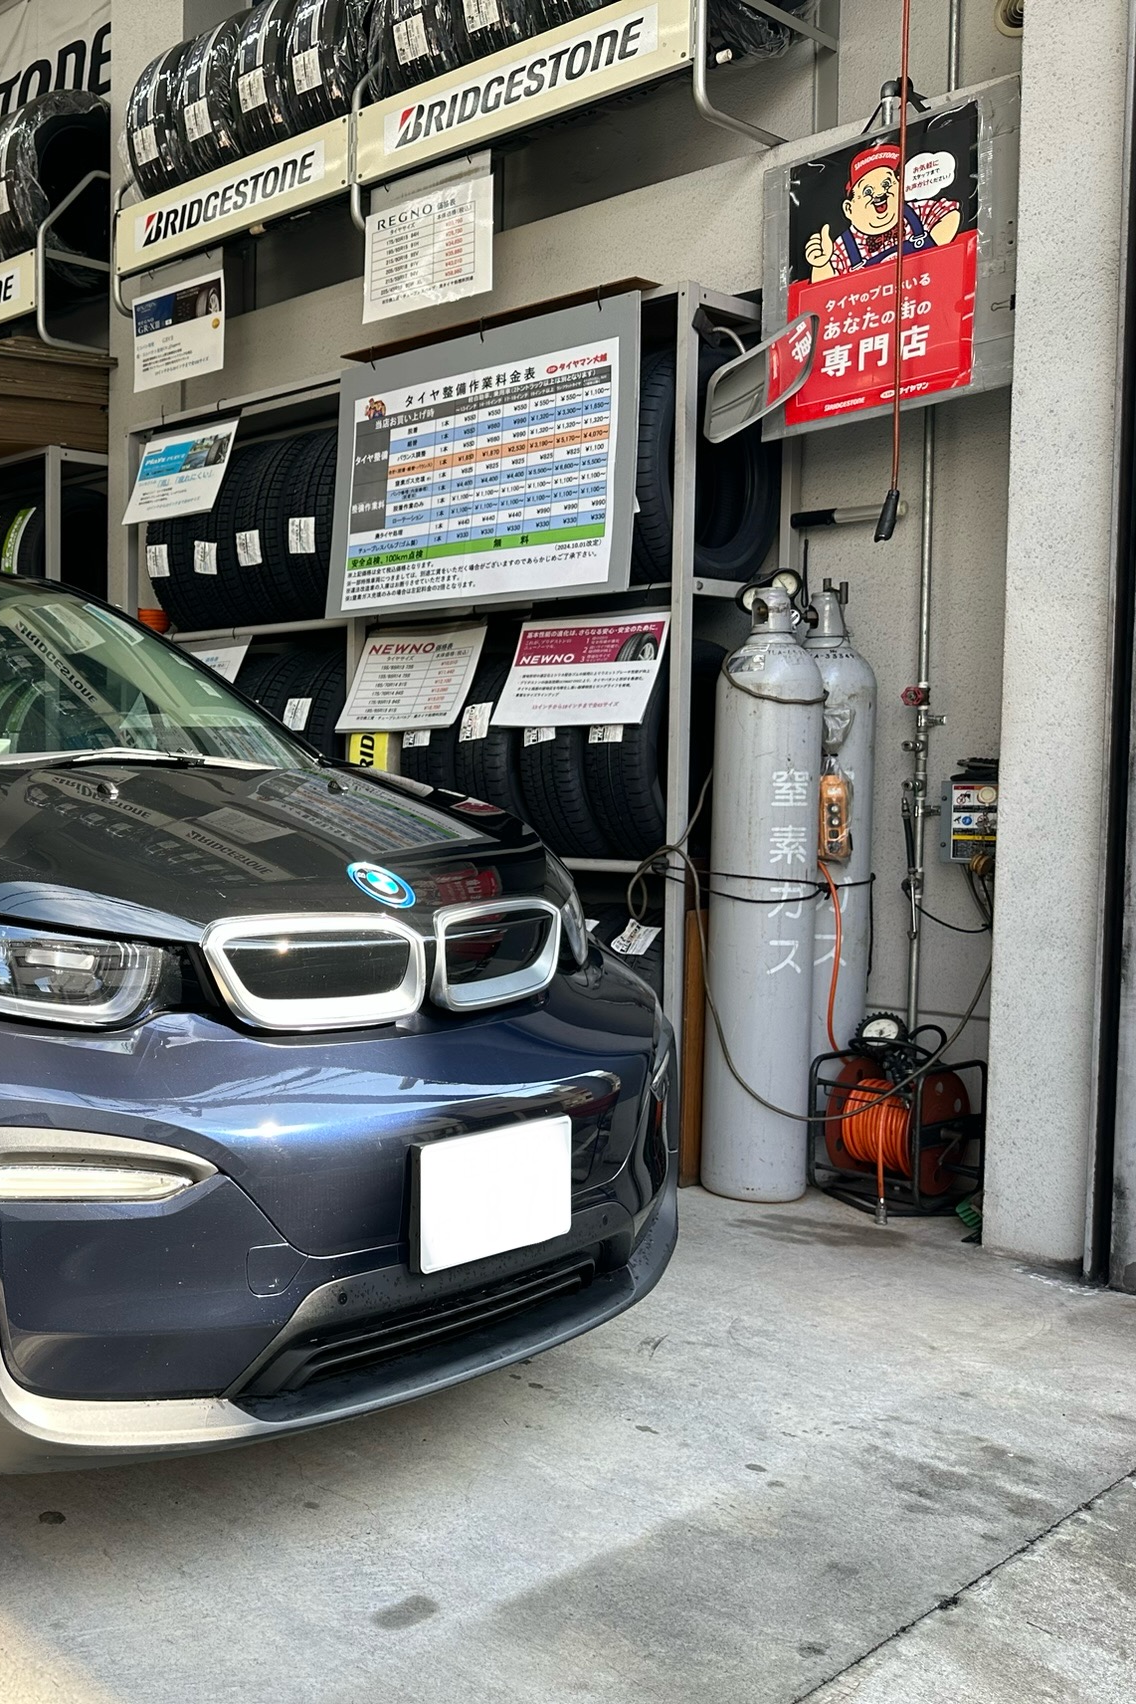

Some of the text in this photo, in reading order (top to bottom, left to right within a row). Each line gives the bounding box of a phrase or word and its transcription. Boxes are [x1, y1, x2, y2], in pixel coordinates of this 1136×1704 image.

[395, 18, 645, 149] BRIDGESTONE
[912, 159, 939, 173] お気軽に
[142, 150, 316, 249] BRIDGESTONE
[377, 202, 432, 230] REGNO
[823, 299, 932, 341] あなたの街の
[820, 324, 930, 377] 専門店
[404, 365, 536, 407] タイヤ整備作業料金表
[823, 397, 866, 412] BRIDGESTONE
[375, 407, 434, 430] 当店お買い上げ時
[354, 450, 388, 466] タイヤ整備
[396, 449, 426, 461] バランス調整
[394, 475, 425, 486] 窒素ガス充填
[351, 499, 385, 514] 整備作業料
[393, 500, 423, 511] 脱着作業のみ
[392, 513, 423, 524] ローテーション
[351, 549, 423, 568] 安全点検、100km点検
[526, 623, 659, 638] 基本性能の進化は、さらなる安心・安全のために。
[366, 638, 438, 658] NEWNO
[518, 653, 575, 664] NEWNO
[766, 768, 809, 974] 窒素ガス
